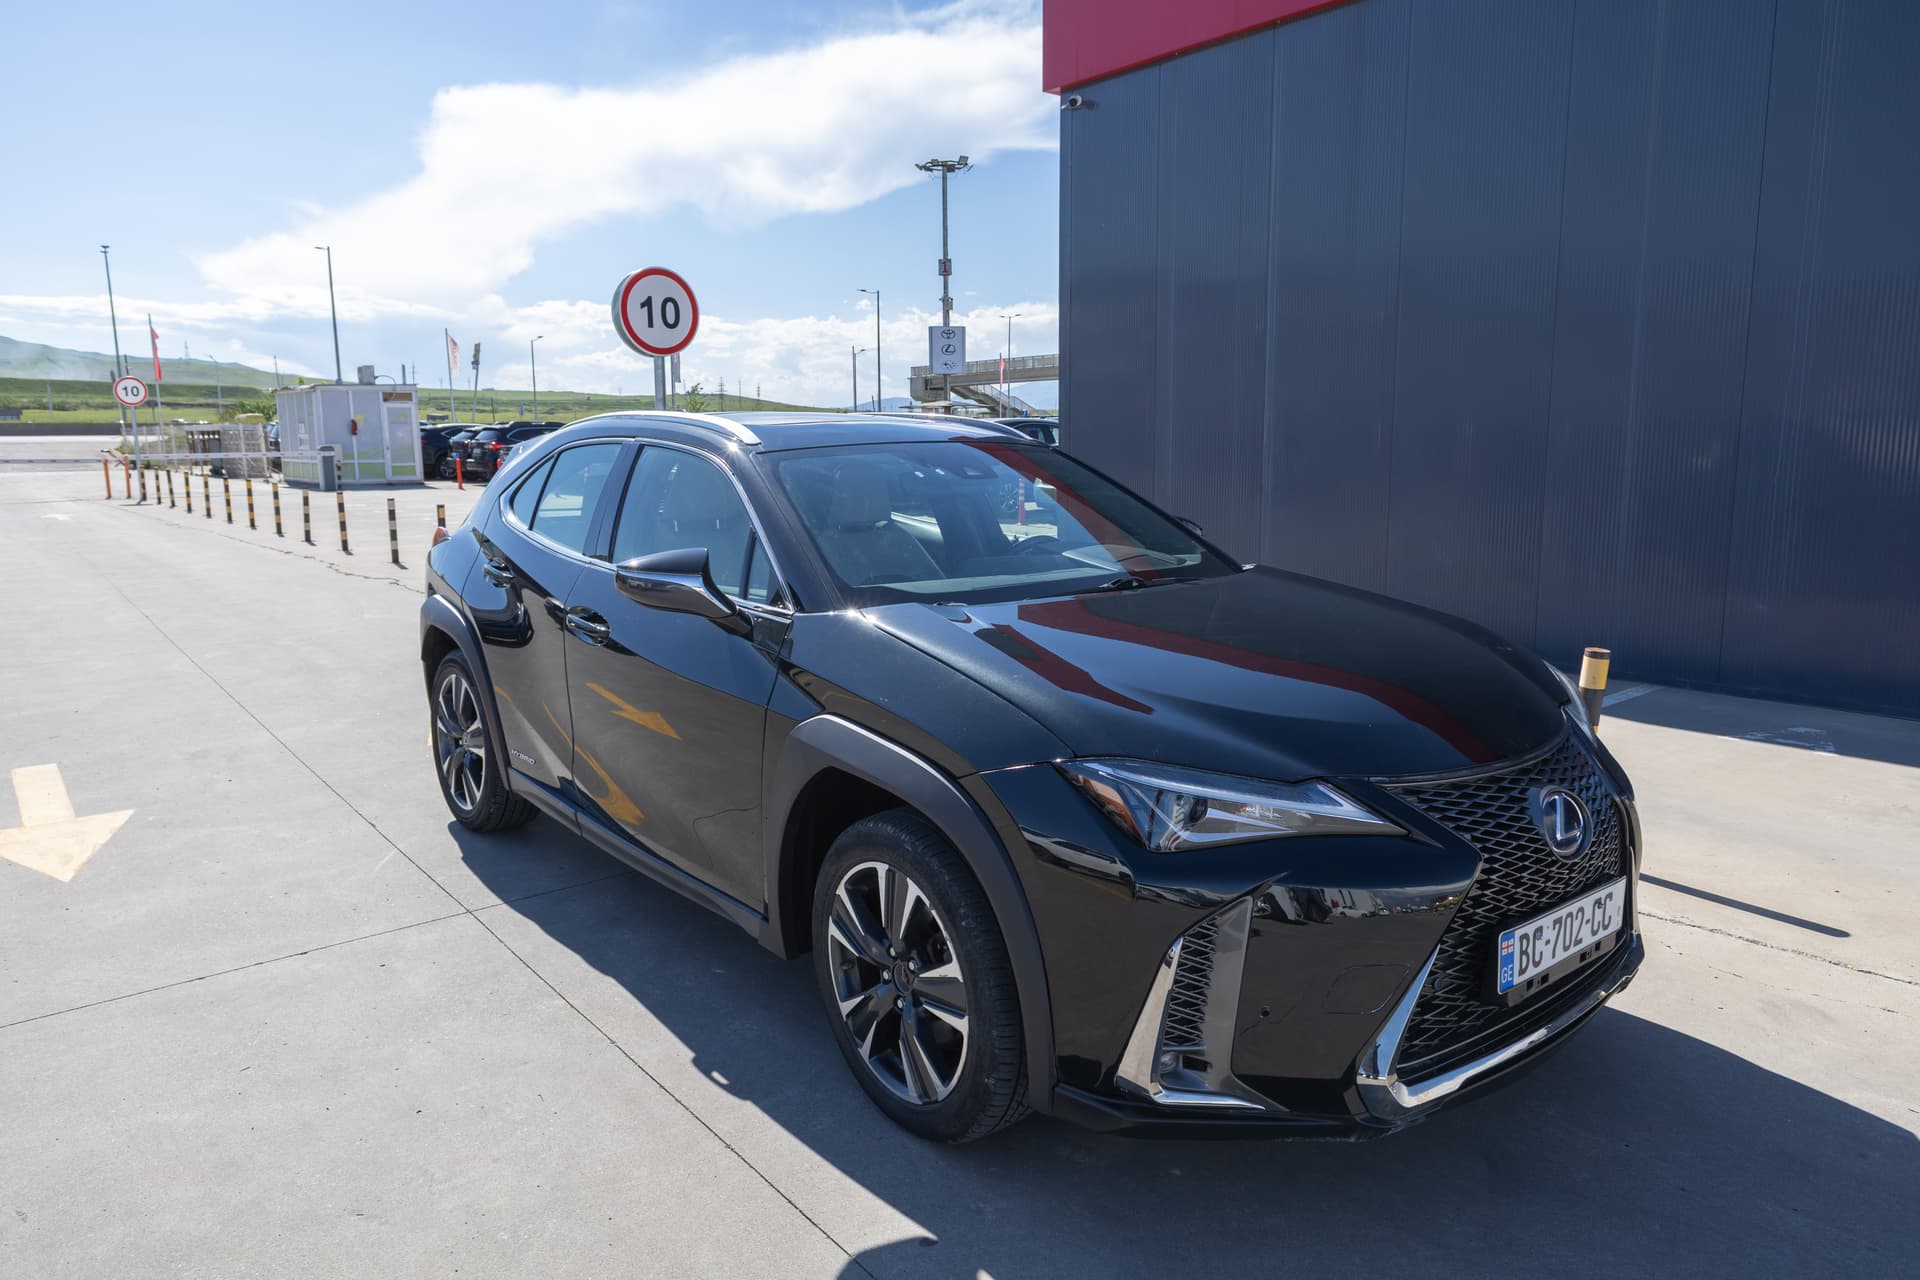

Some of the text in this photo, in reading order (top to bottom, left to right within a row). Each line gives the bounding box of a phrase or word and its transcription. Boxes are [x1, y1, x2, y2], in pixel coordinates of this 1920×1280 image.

[640, 296, 680, 329] 10
[122, 386, 140, 397] 10
[1518, 892, 1613, 977] BC-702-CC
[1501, 964, 1513, 983] GE
